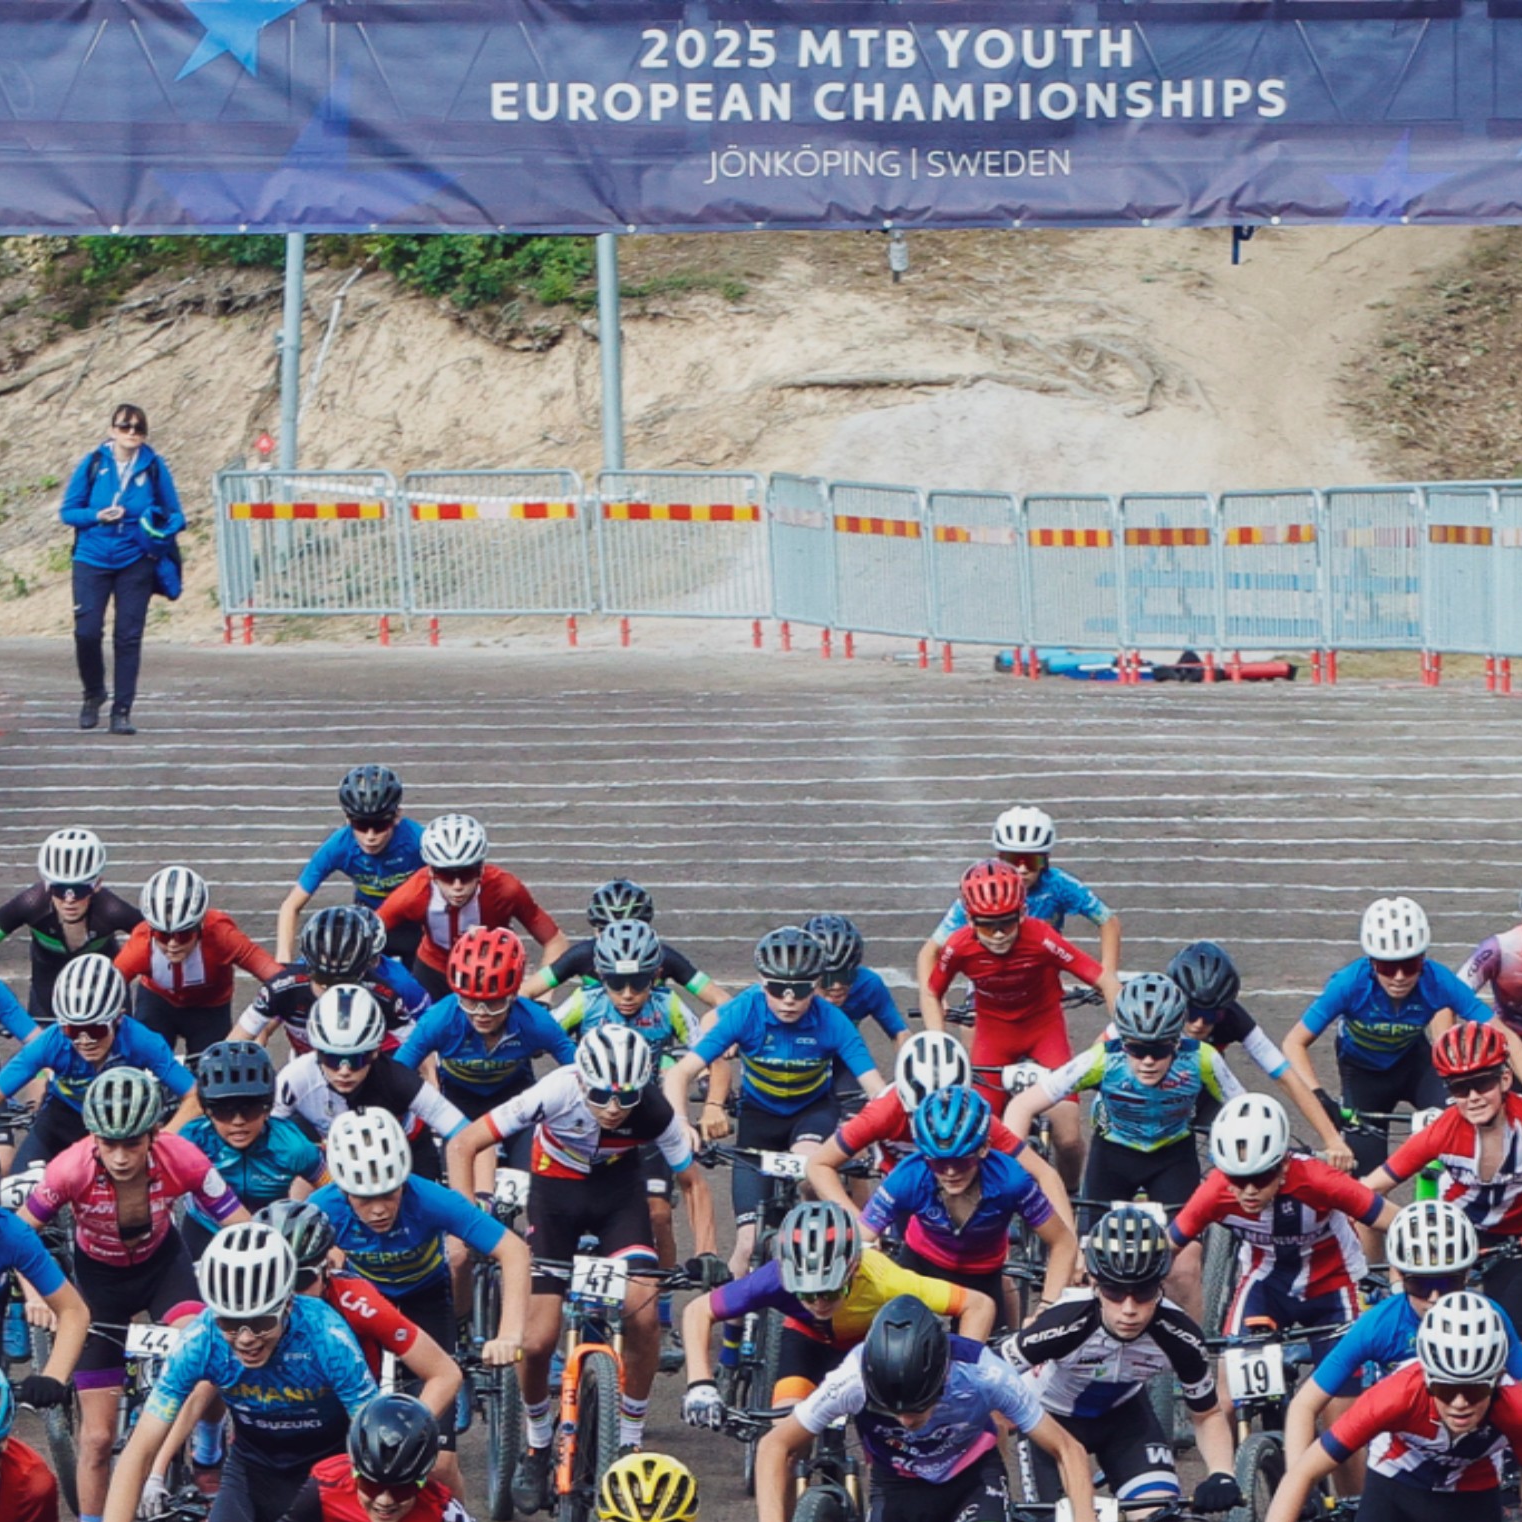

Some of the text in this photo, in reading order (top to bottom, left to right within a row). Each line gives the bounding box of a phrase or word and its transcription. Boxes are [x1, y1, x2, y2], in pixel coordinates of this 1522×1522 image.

[640, 28, 1134, 69] 2025 MTB YOUTH
[491, 77, 1286, 122] EUROPEAN CHAMPIONSHIPS
[704, 142, 1071, 184] JÖNKÖPING SWEDEN
[773, 1157, 802, 1176] 53
[339, 1291, 378, 1319] Liv
[139, 1329, 170, 1353] 44
[1240, 1360, 1271, 1395] 19
[255, 1418, 324, 1430] SUZUKI
